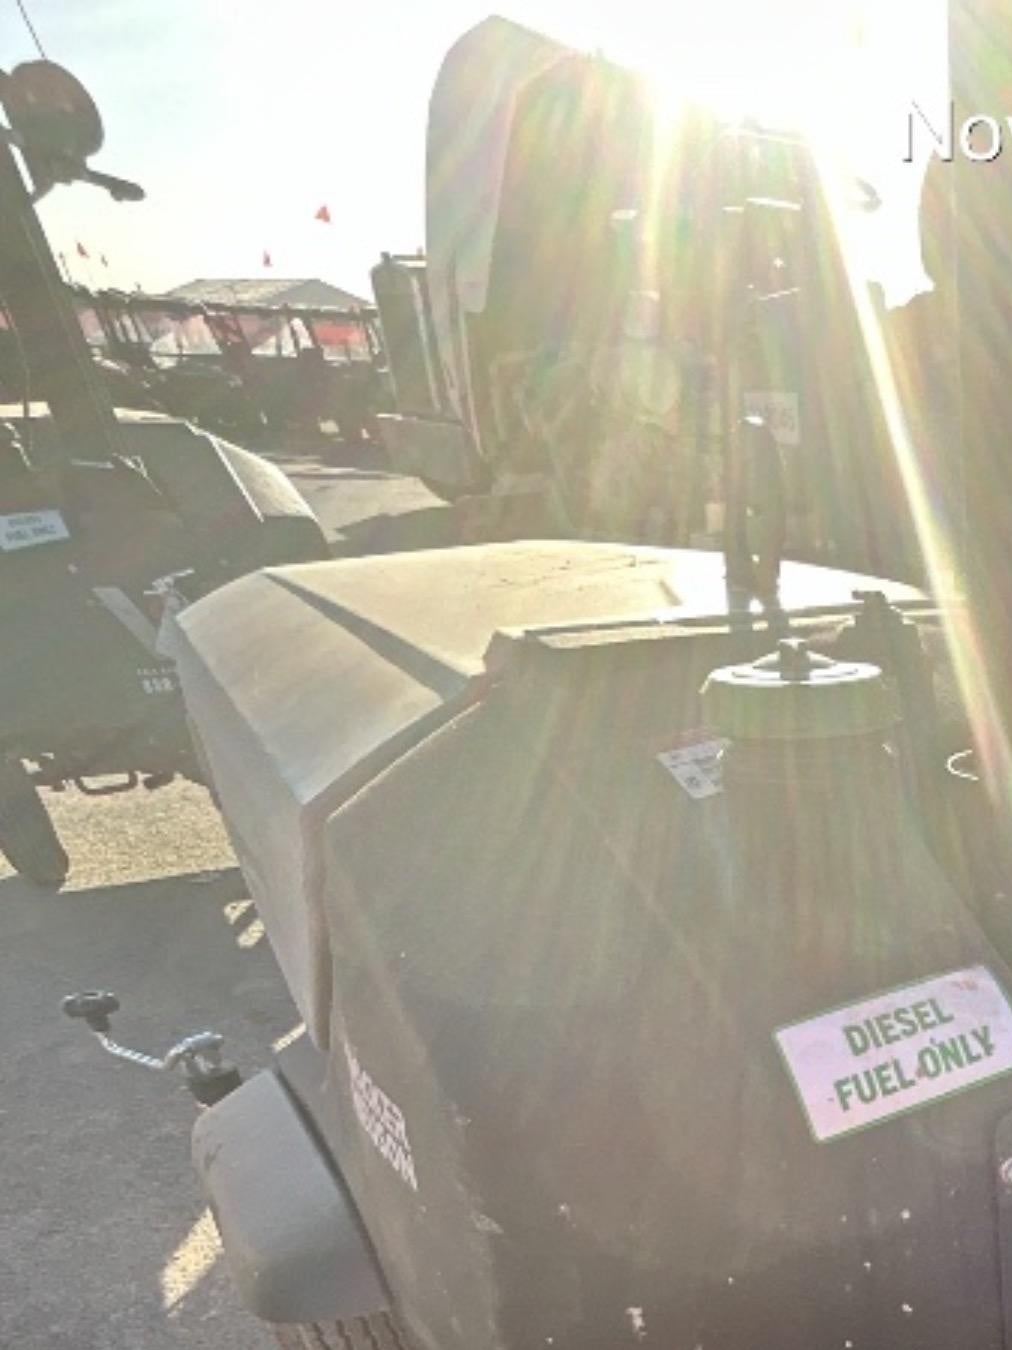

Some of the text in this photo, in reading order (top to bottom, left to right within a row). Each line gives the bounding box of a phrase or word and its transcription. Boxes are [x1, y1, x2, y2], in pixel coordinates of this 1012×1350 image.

[842, 998, 955, 1057] DIESEL
[833, 1025, 996, 1113] FUEL ONLY
